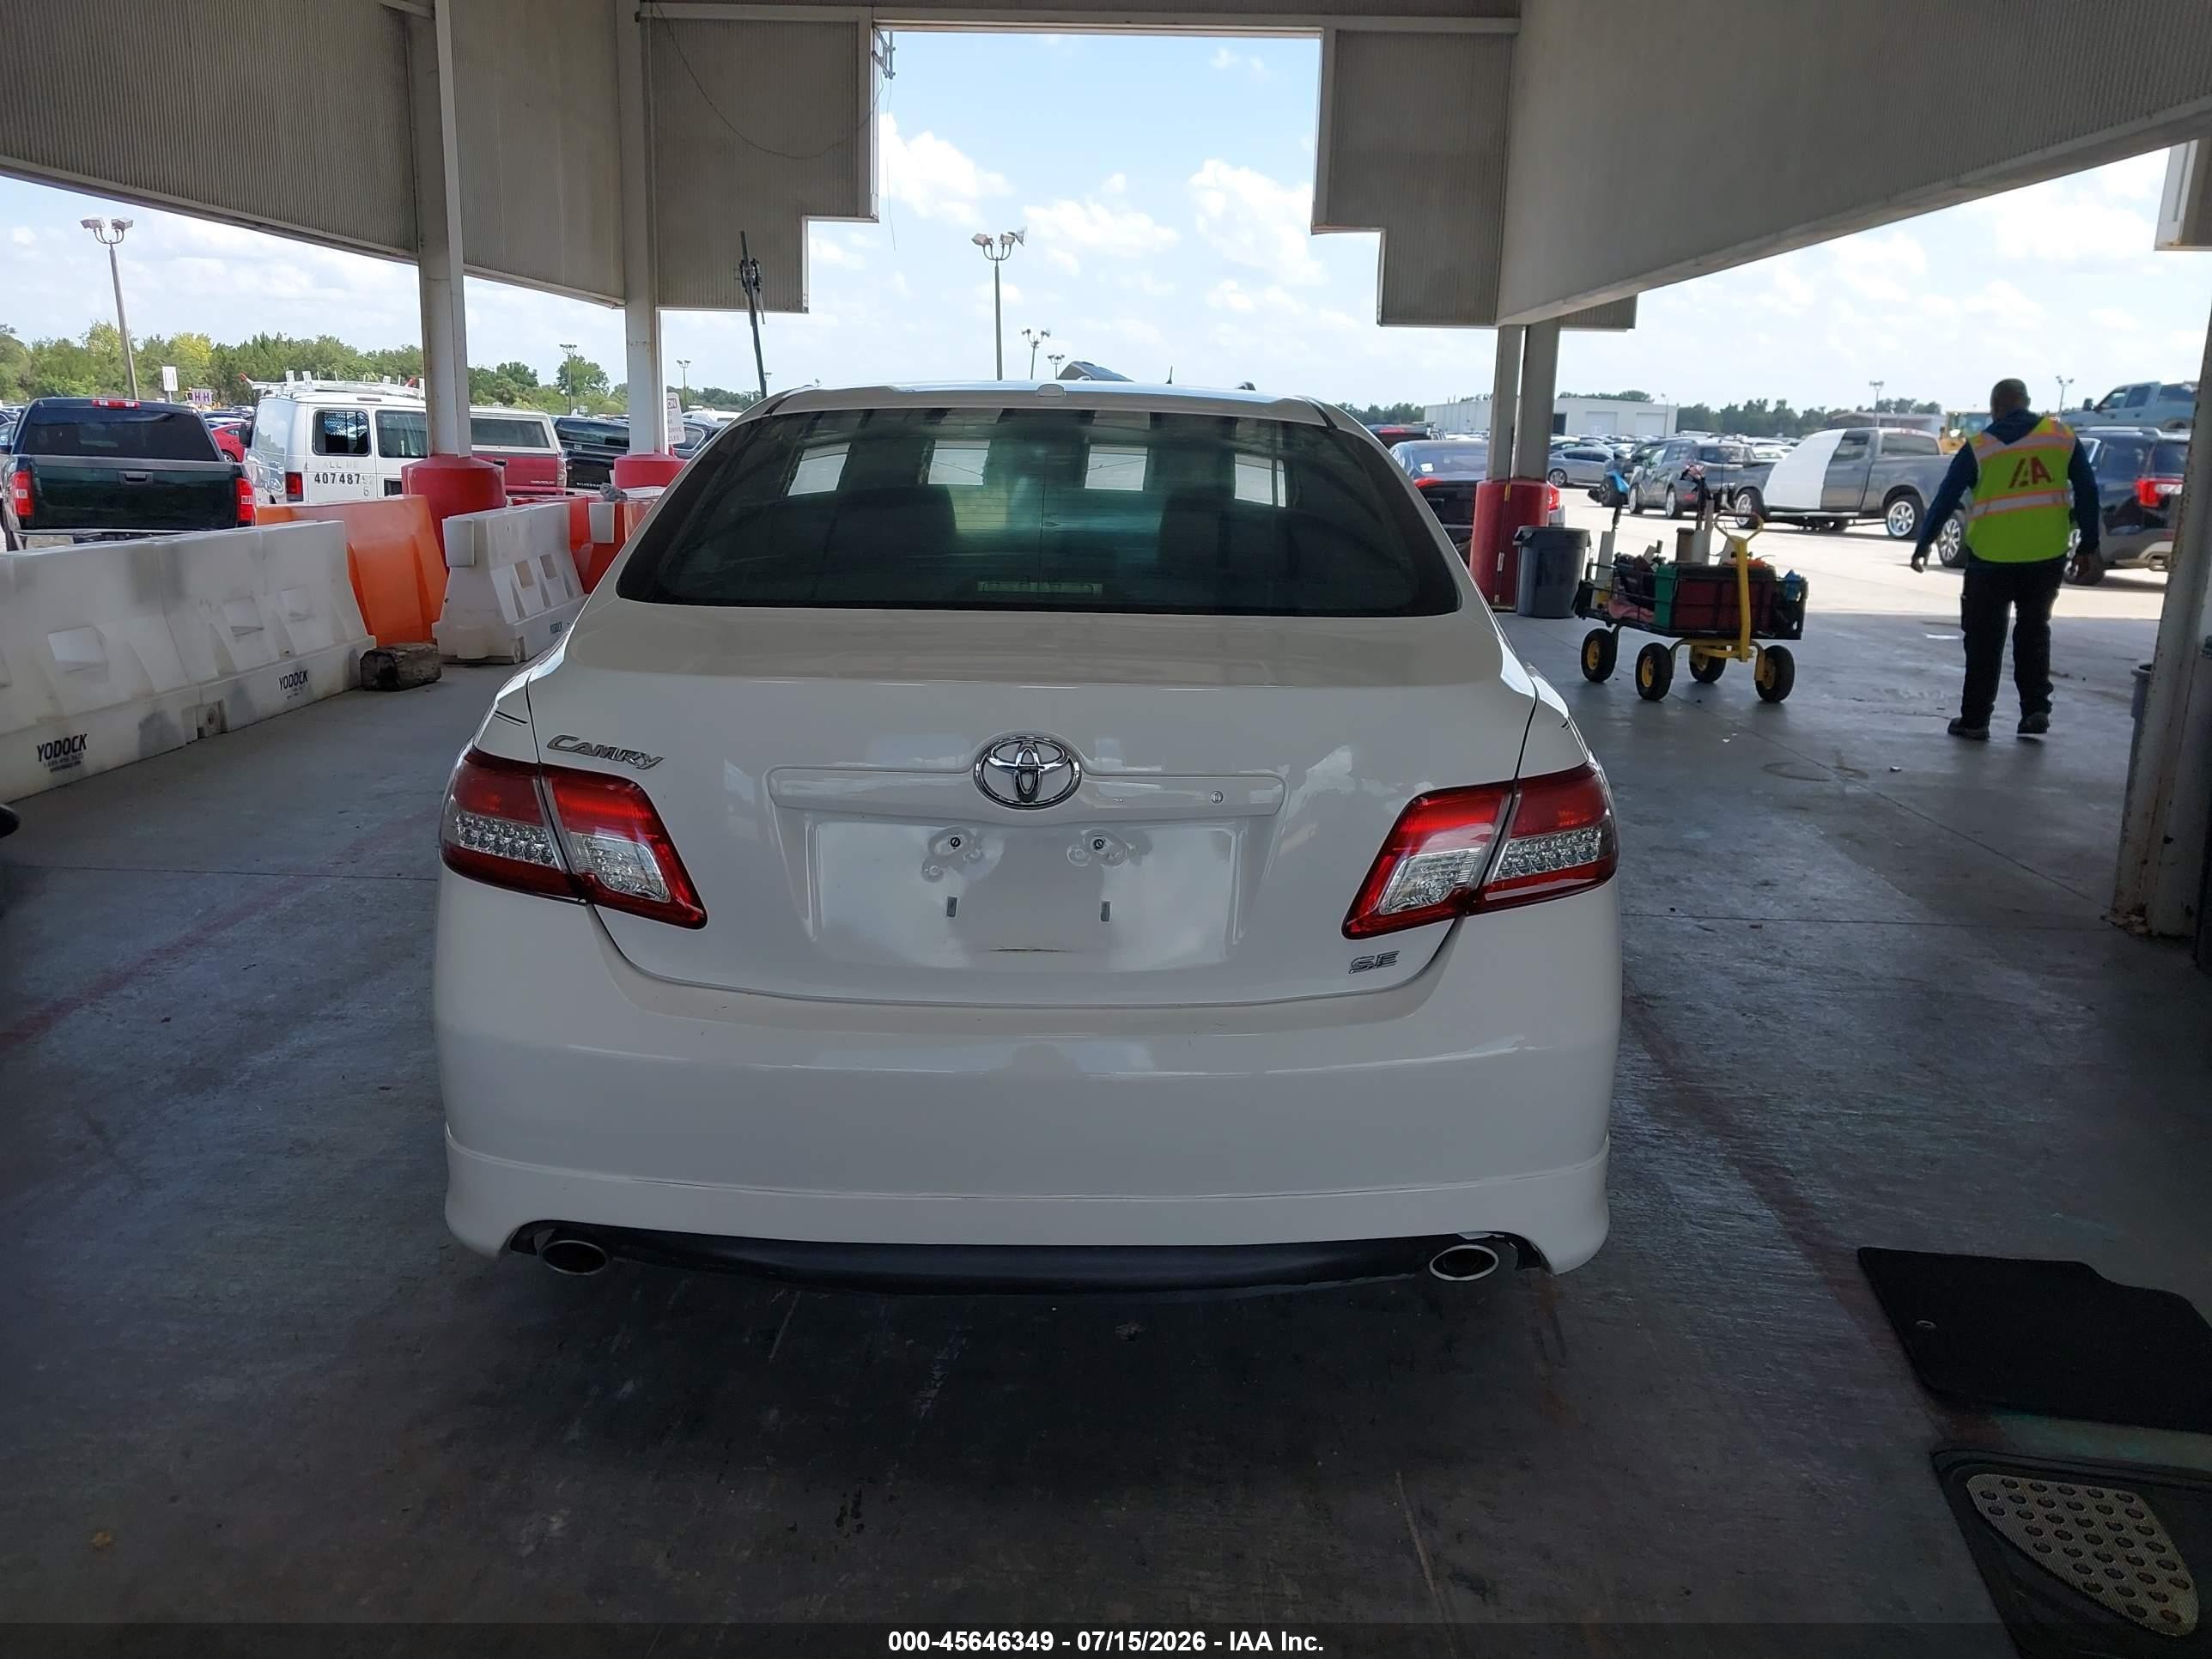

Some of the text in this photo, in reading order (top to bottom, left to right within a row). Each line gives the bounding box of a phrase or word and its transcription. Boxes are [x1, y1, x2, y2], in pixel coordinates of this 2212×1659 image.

[278, 669, 308, 691] YODOCK
[37, 733, 88, 763] YODOCK
[546, 734, 665, 770] CAMRY
[1348, 950, 1401, 975] SE
